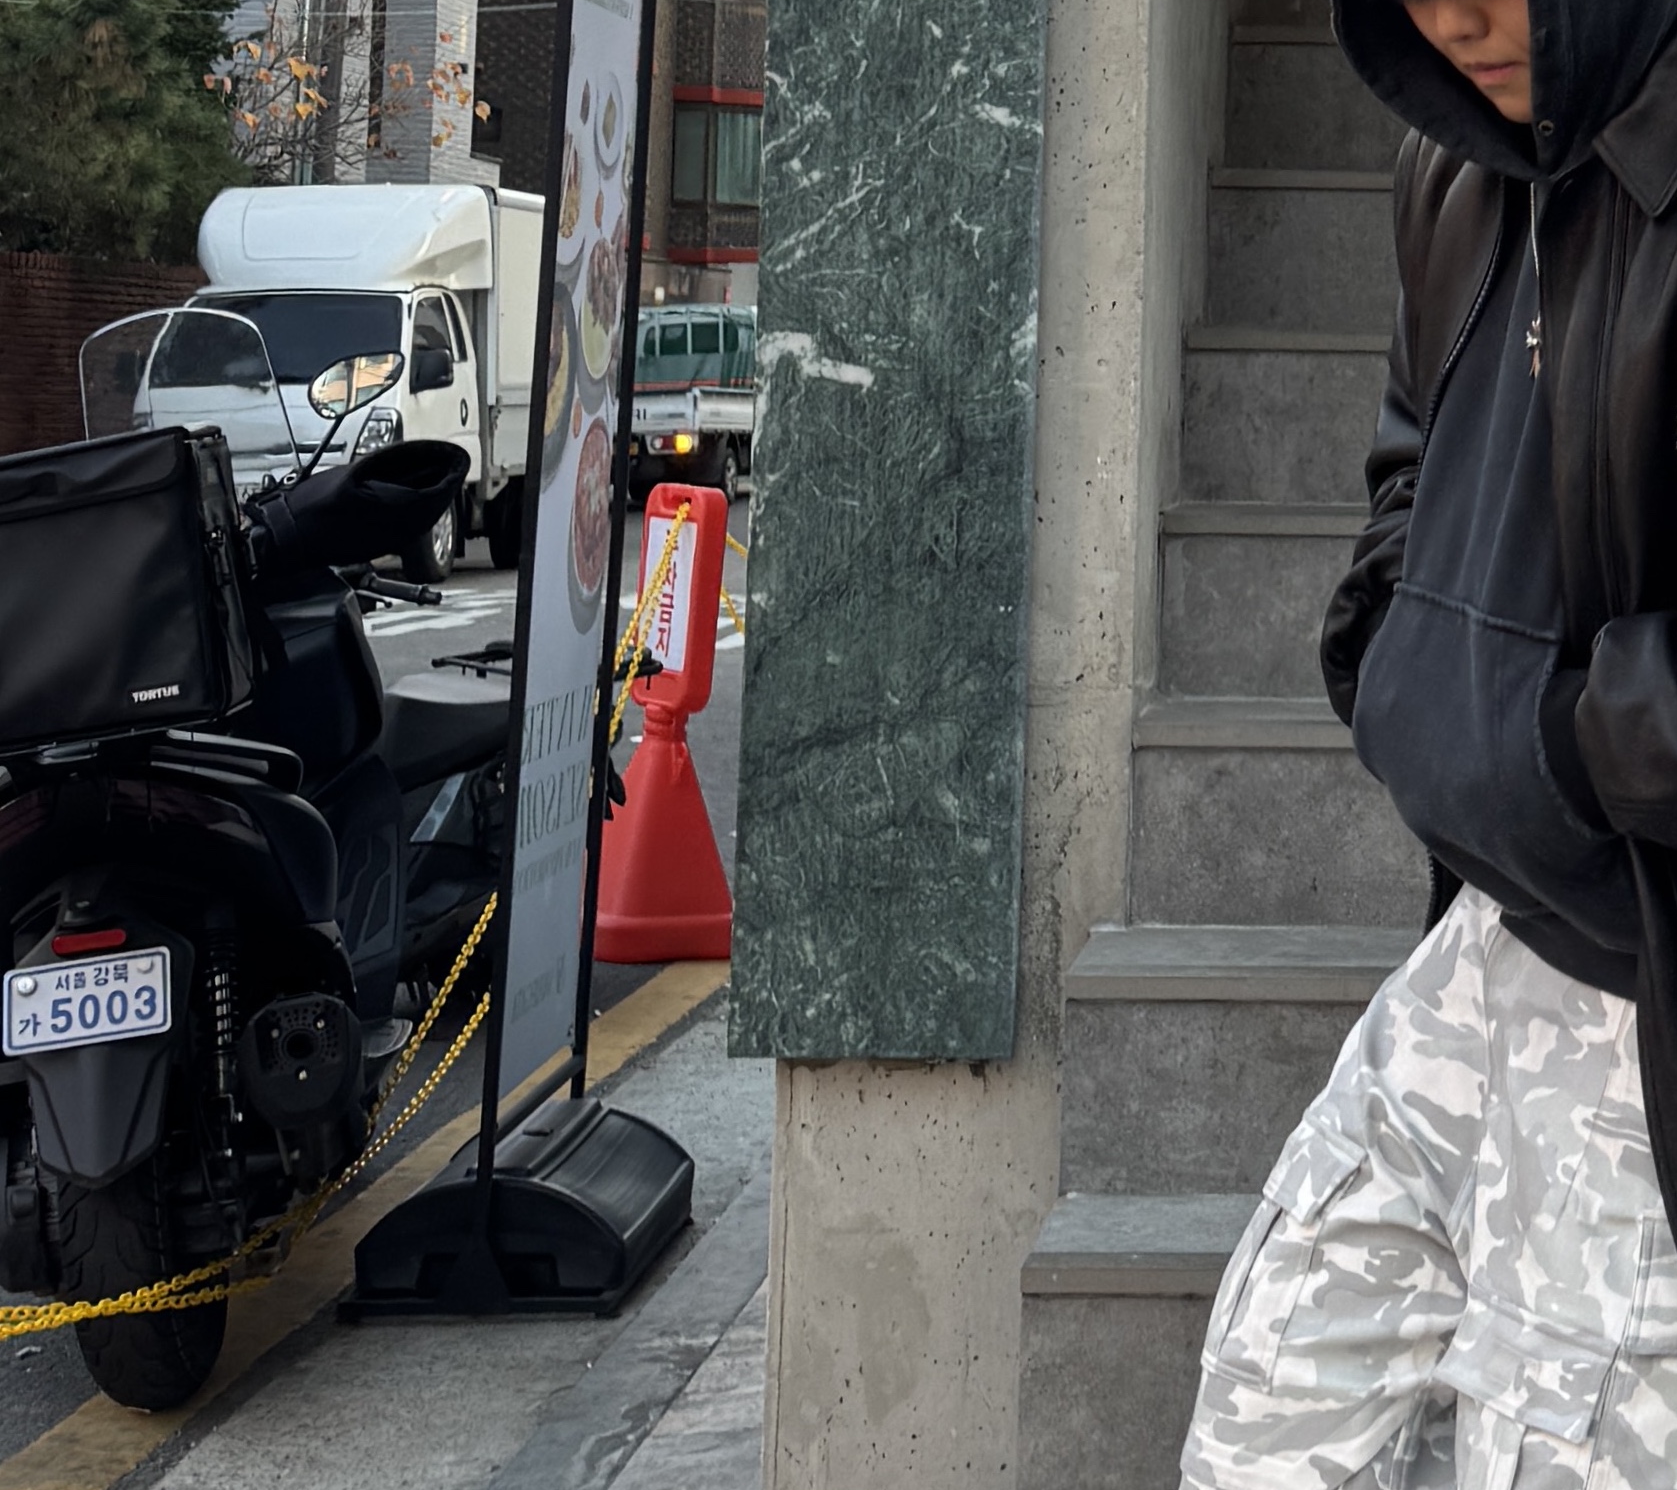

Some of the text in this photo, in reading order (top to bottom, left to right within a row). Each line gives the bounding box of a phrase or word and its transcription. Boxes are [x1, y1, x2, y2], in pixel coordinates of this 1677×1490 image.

[55, 963, 129, 991] 서울 강북
[18, 985, 157, 1037] 가 5003
